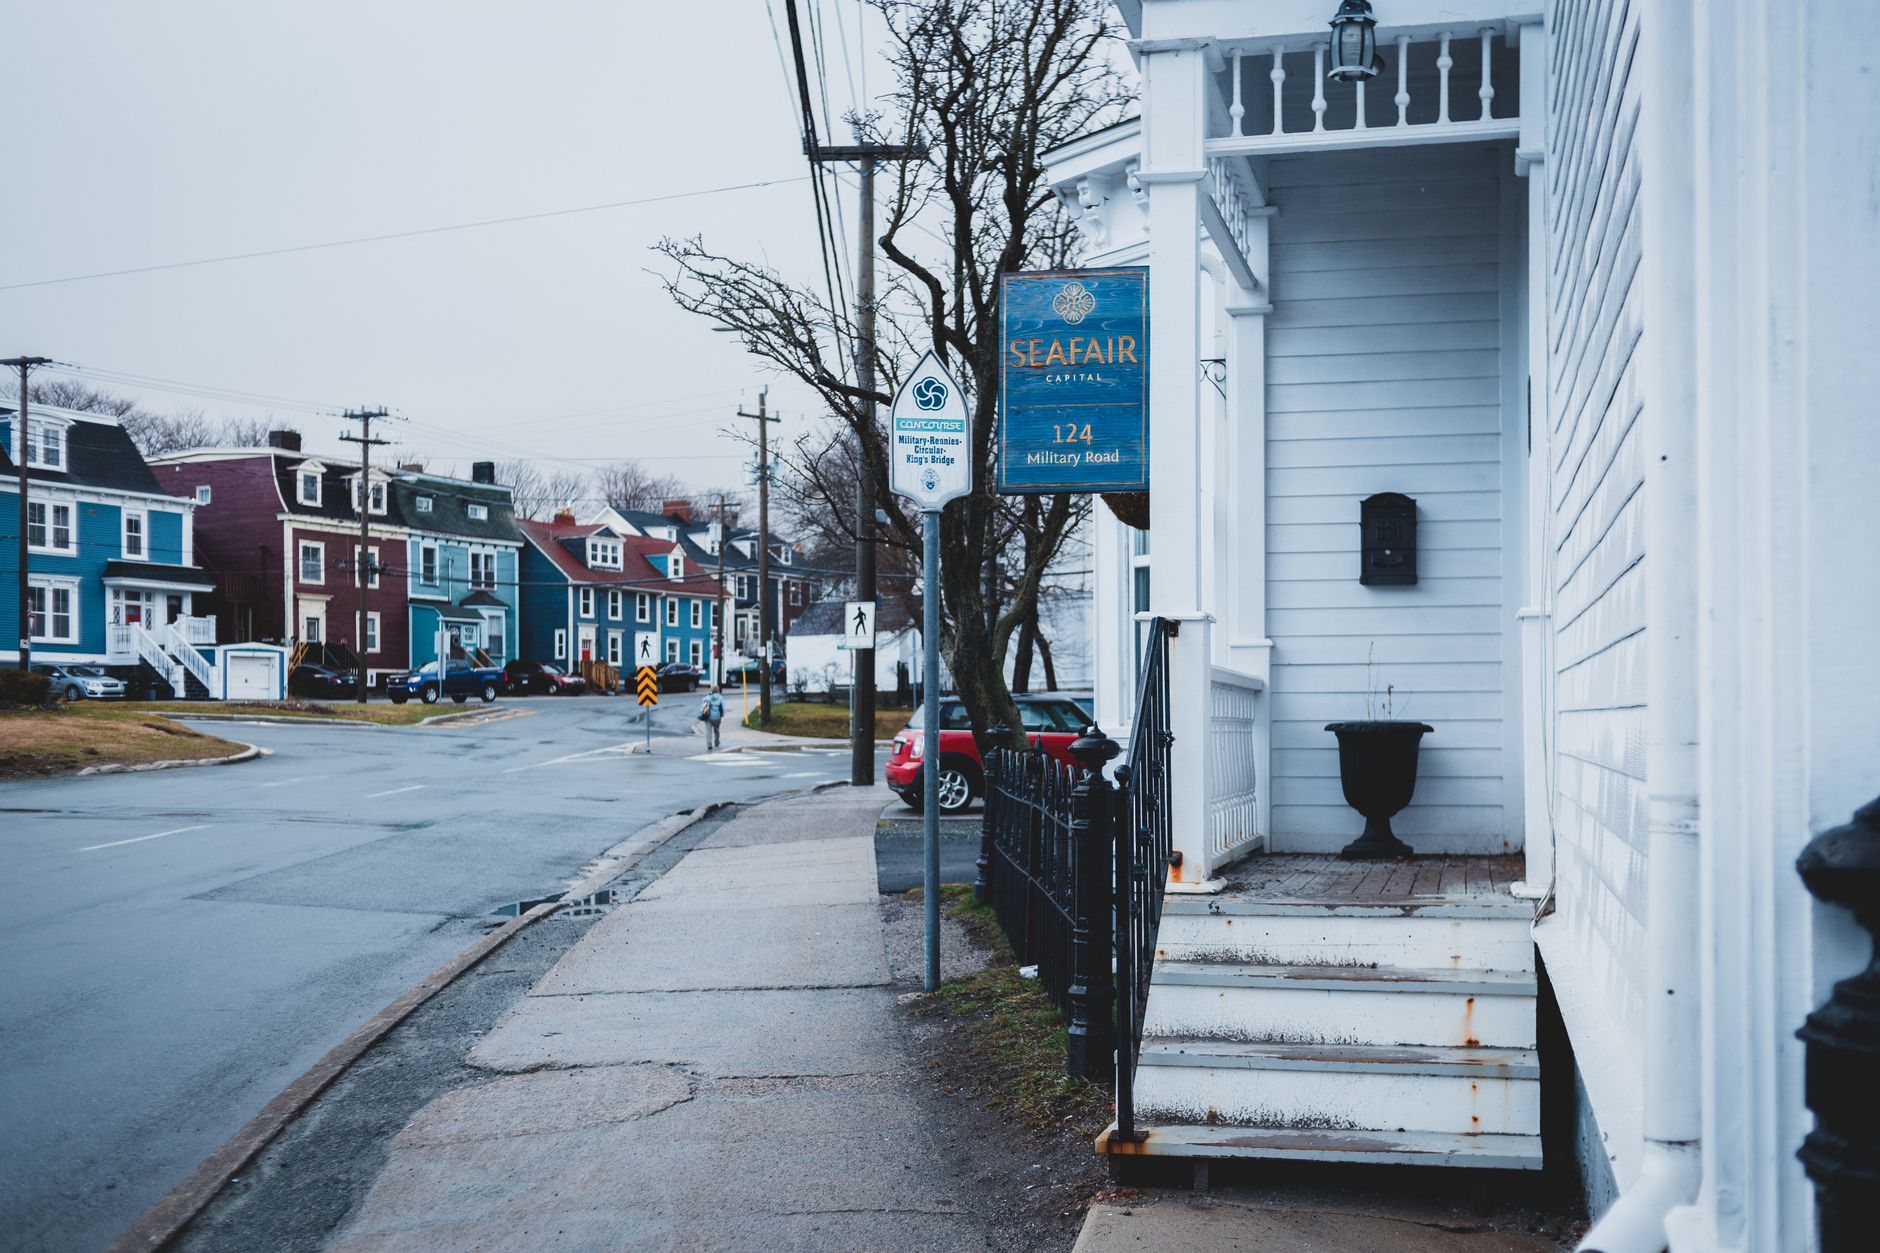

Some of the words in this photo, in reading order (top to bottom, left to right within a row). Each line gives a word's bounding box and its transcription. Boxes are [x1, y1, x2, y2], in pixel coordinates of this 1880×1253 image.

[1009, 335, 1138, 368] SEAFAIR
[1045, 373, 1101, 383] CAPITAL
[900, 420, 962, 430] CONCOURSE
[1052, 423, 1093, 446] 124
[906, 454, 928, 465] King's
[931, 455, 955, 466] Bridge
[1027, 450, 1081, 467] Military
[1085, 449, 1119, 463] Road
